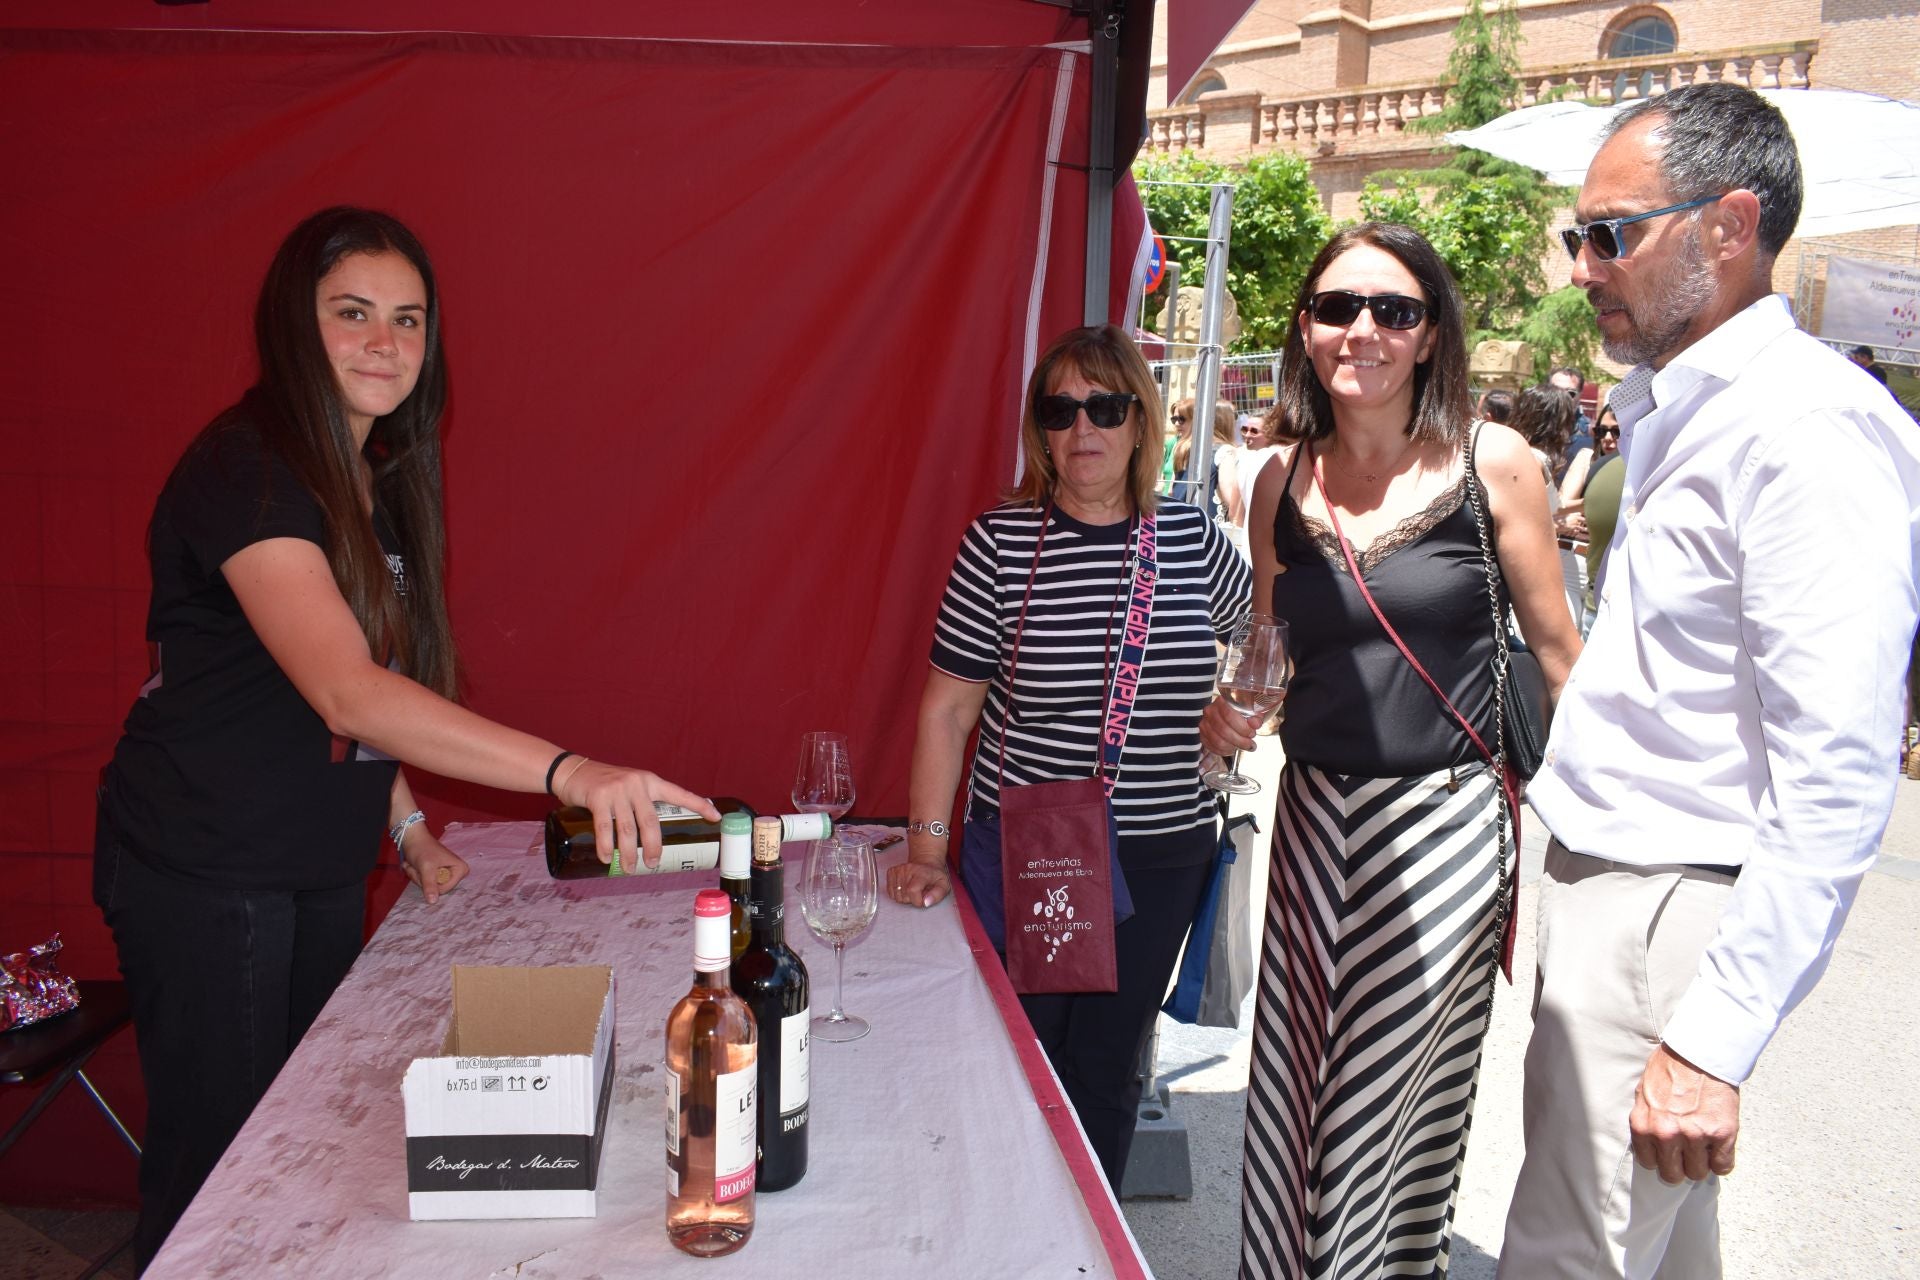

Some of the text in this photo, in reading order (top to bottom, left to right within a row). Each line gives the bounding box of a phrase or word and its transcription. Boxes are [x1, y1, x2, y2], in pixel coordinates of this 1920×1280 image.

[1018, 870, 1062, 879] Aldeanueva
[1064, 869, 1074, 877] de
[455, 1057, 542, 1071] info@bodegasmateos.com
[426, 1155, 494, 1180] Bodegas
[520, 1154, 580, 1170] Mateos
